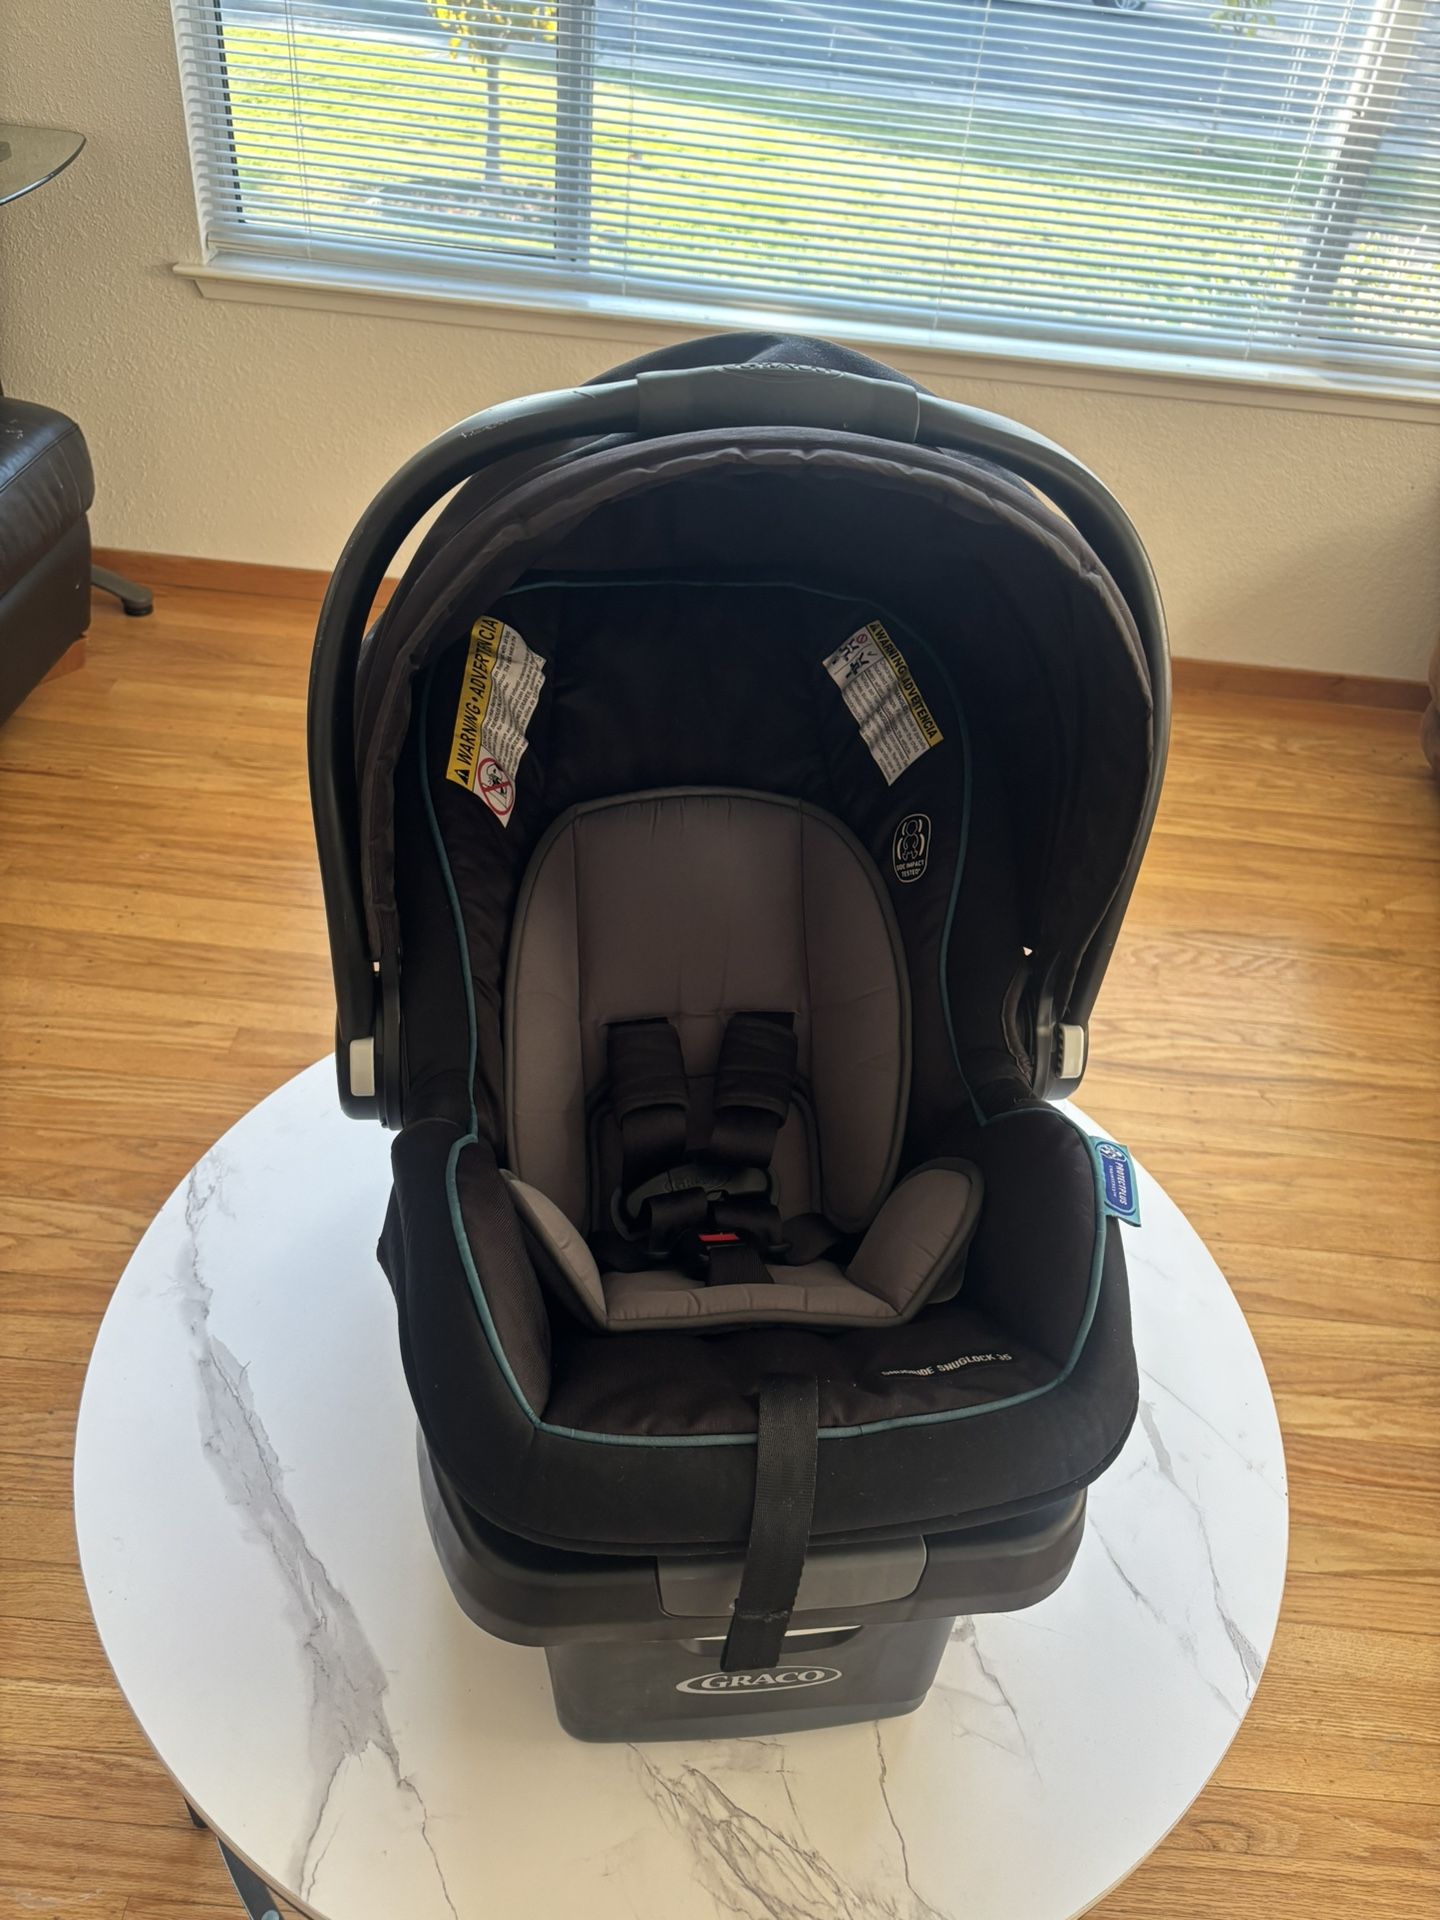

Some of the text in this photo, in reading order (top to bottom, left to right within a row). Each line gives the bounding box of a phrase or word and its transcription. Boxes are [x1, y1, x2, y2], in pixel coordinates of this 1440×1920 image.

[875, 628, 906, 675] WARNING
[457, 702, 480, 765] WARNING
[937, 1354, 996, 1371] SNUGLOCK
[701, 1670, 825, 1689] GRACO
